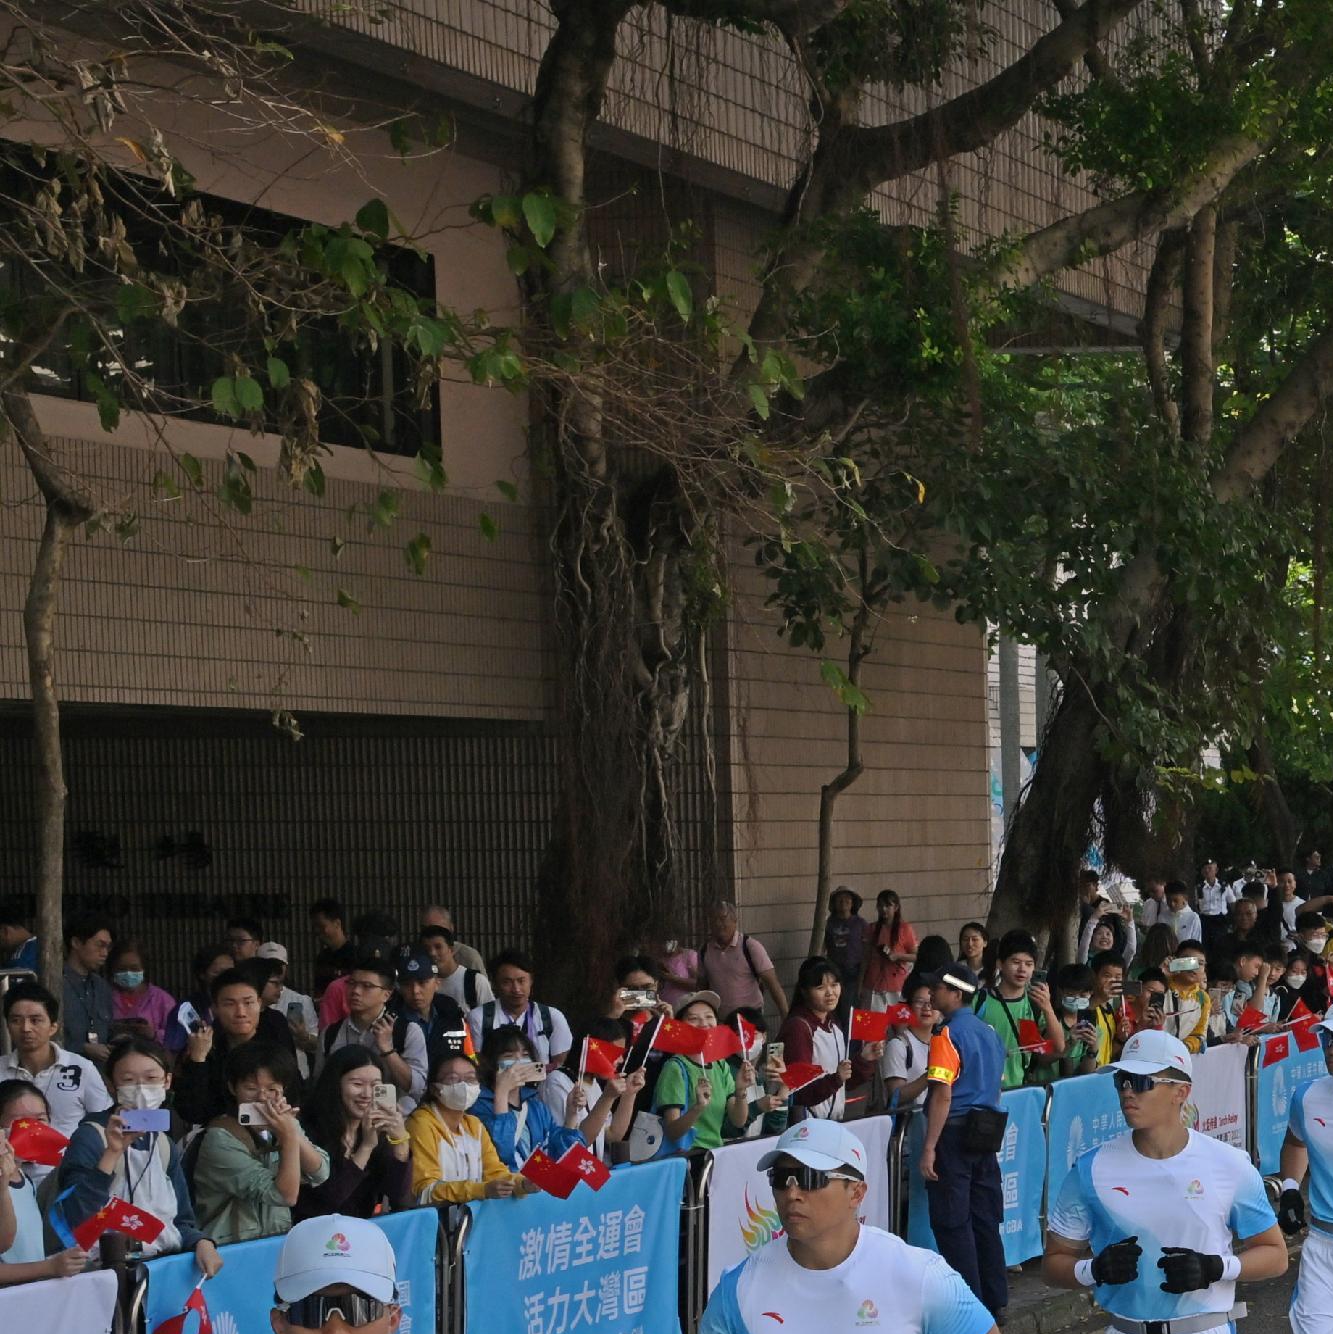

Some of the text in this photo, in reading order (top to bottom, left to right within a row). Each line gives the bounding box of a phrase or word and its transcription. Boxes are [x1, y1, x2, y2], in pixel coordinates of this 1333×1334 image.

[57, 1064, 82, 1092] 3
[518, 1204, 646, 1281] 激情全運會
